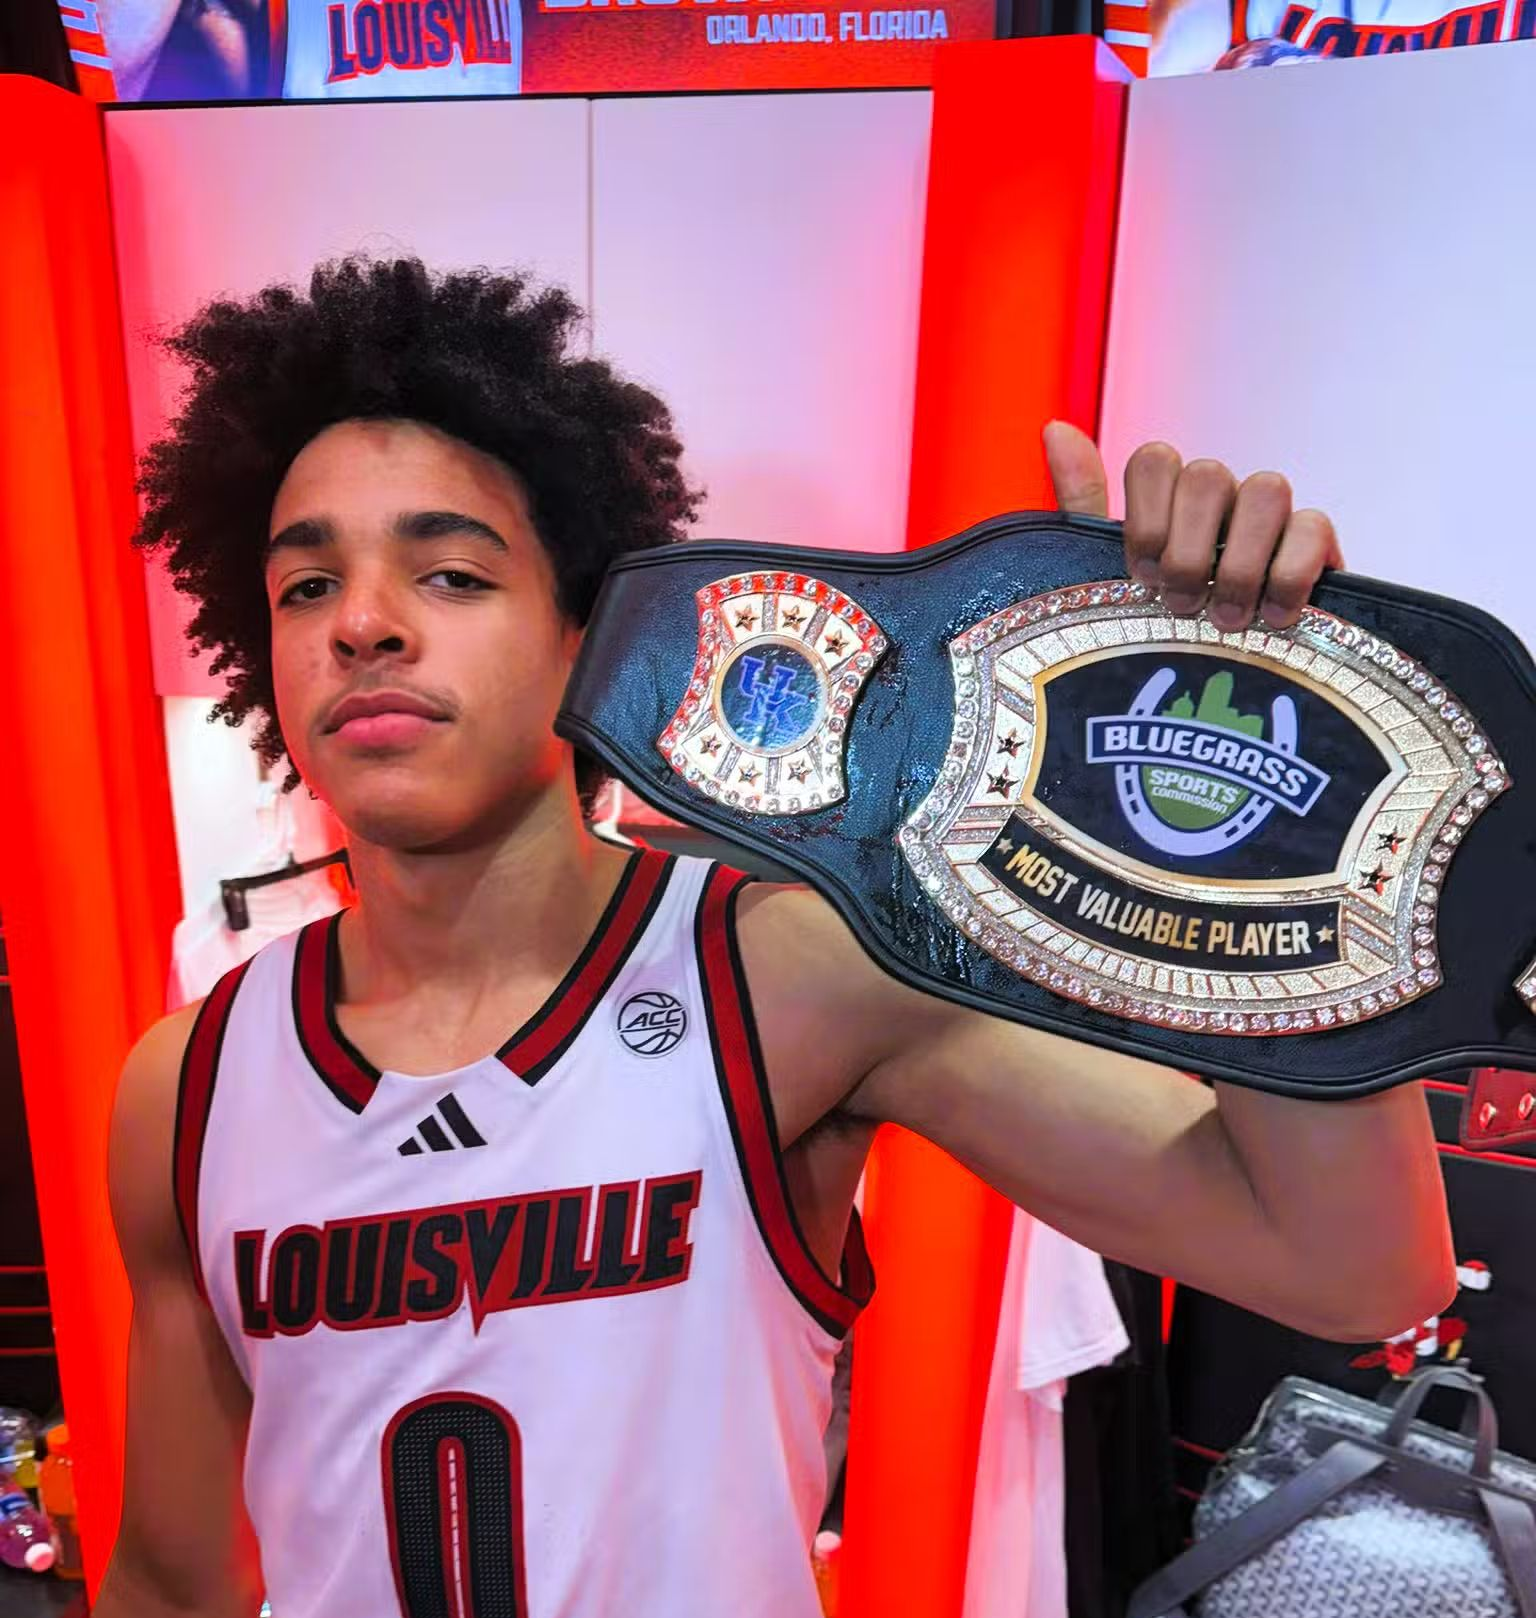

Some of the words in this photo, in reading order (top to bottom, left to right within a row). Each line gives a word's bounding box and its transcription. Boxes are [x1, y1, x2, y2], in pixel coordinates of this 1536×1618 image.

[706, 14, 832, 44] ORLANDO,
[839, 10, 948, 41] FLORIDA
[1104, 725, 1308, 797] BLUEGRASS
[1149, 769, 1239, 804] SPORTS
[1152, 786, 1229, 814] commission
[1004, 844, 1078, 904] MOST
[1076, 883, 1202, 950] VALUABLE
[1207, 920, 1313, 956] PLAYER
[625, 1007, 684, 1029] ACC
[234, 1169, 703, 1338] LOUISVILLE
[381, 1391, 529, 1618] 0
